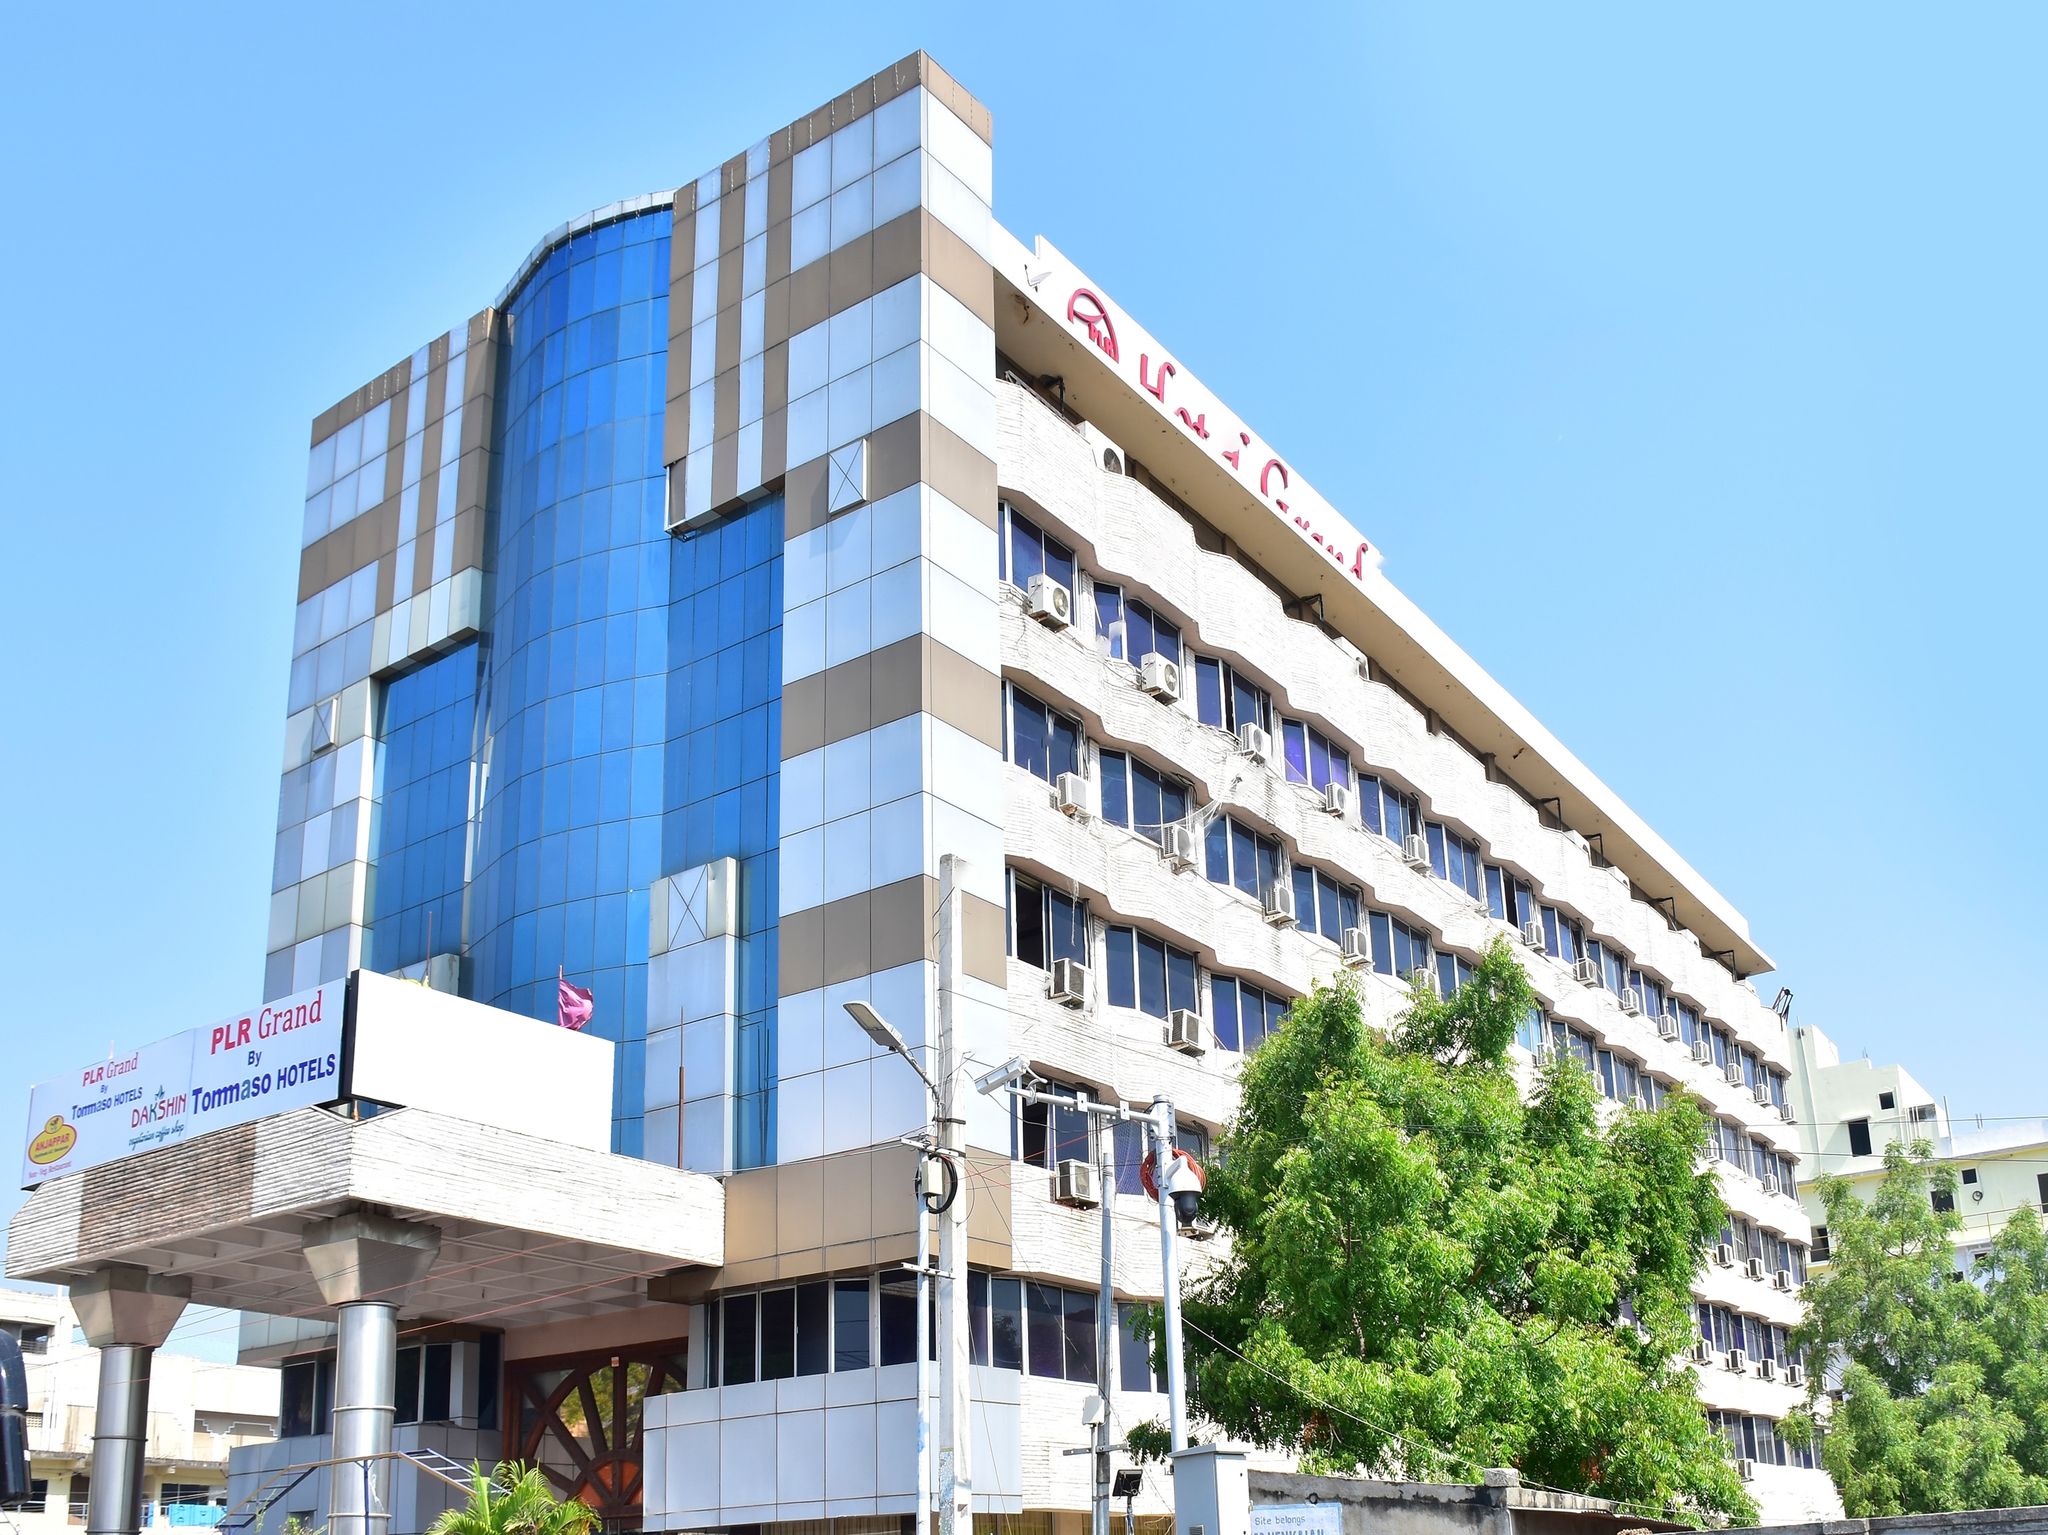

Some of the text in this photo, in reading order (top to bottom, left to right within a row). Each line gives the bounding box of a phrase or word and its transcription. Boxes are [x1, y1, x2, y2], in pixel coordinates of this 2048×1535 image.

[211, 990, 323, 1055] PLR Grand
[82, 1052, 139, 1087] PLR Grand
[248, 1050, 262, 1067] By
[192, 1053, 336, 1115] Tommaso HOTELS
[72, 1087, 143, 1120] Tommaso HOTELS
[131, 1093, 187, 1128] DAKSHIN
[1254, 1515, 1306, 1526] Site belongs
